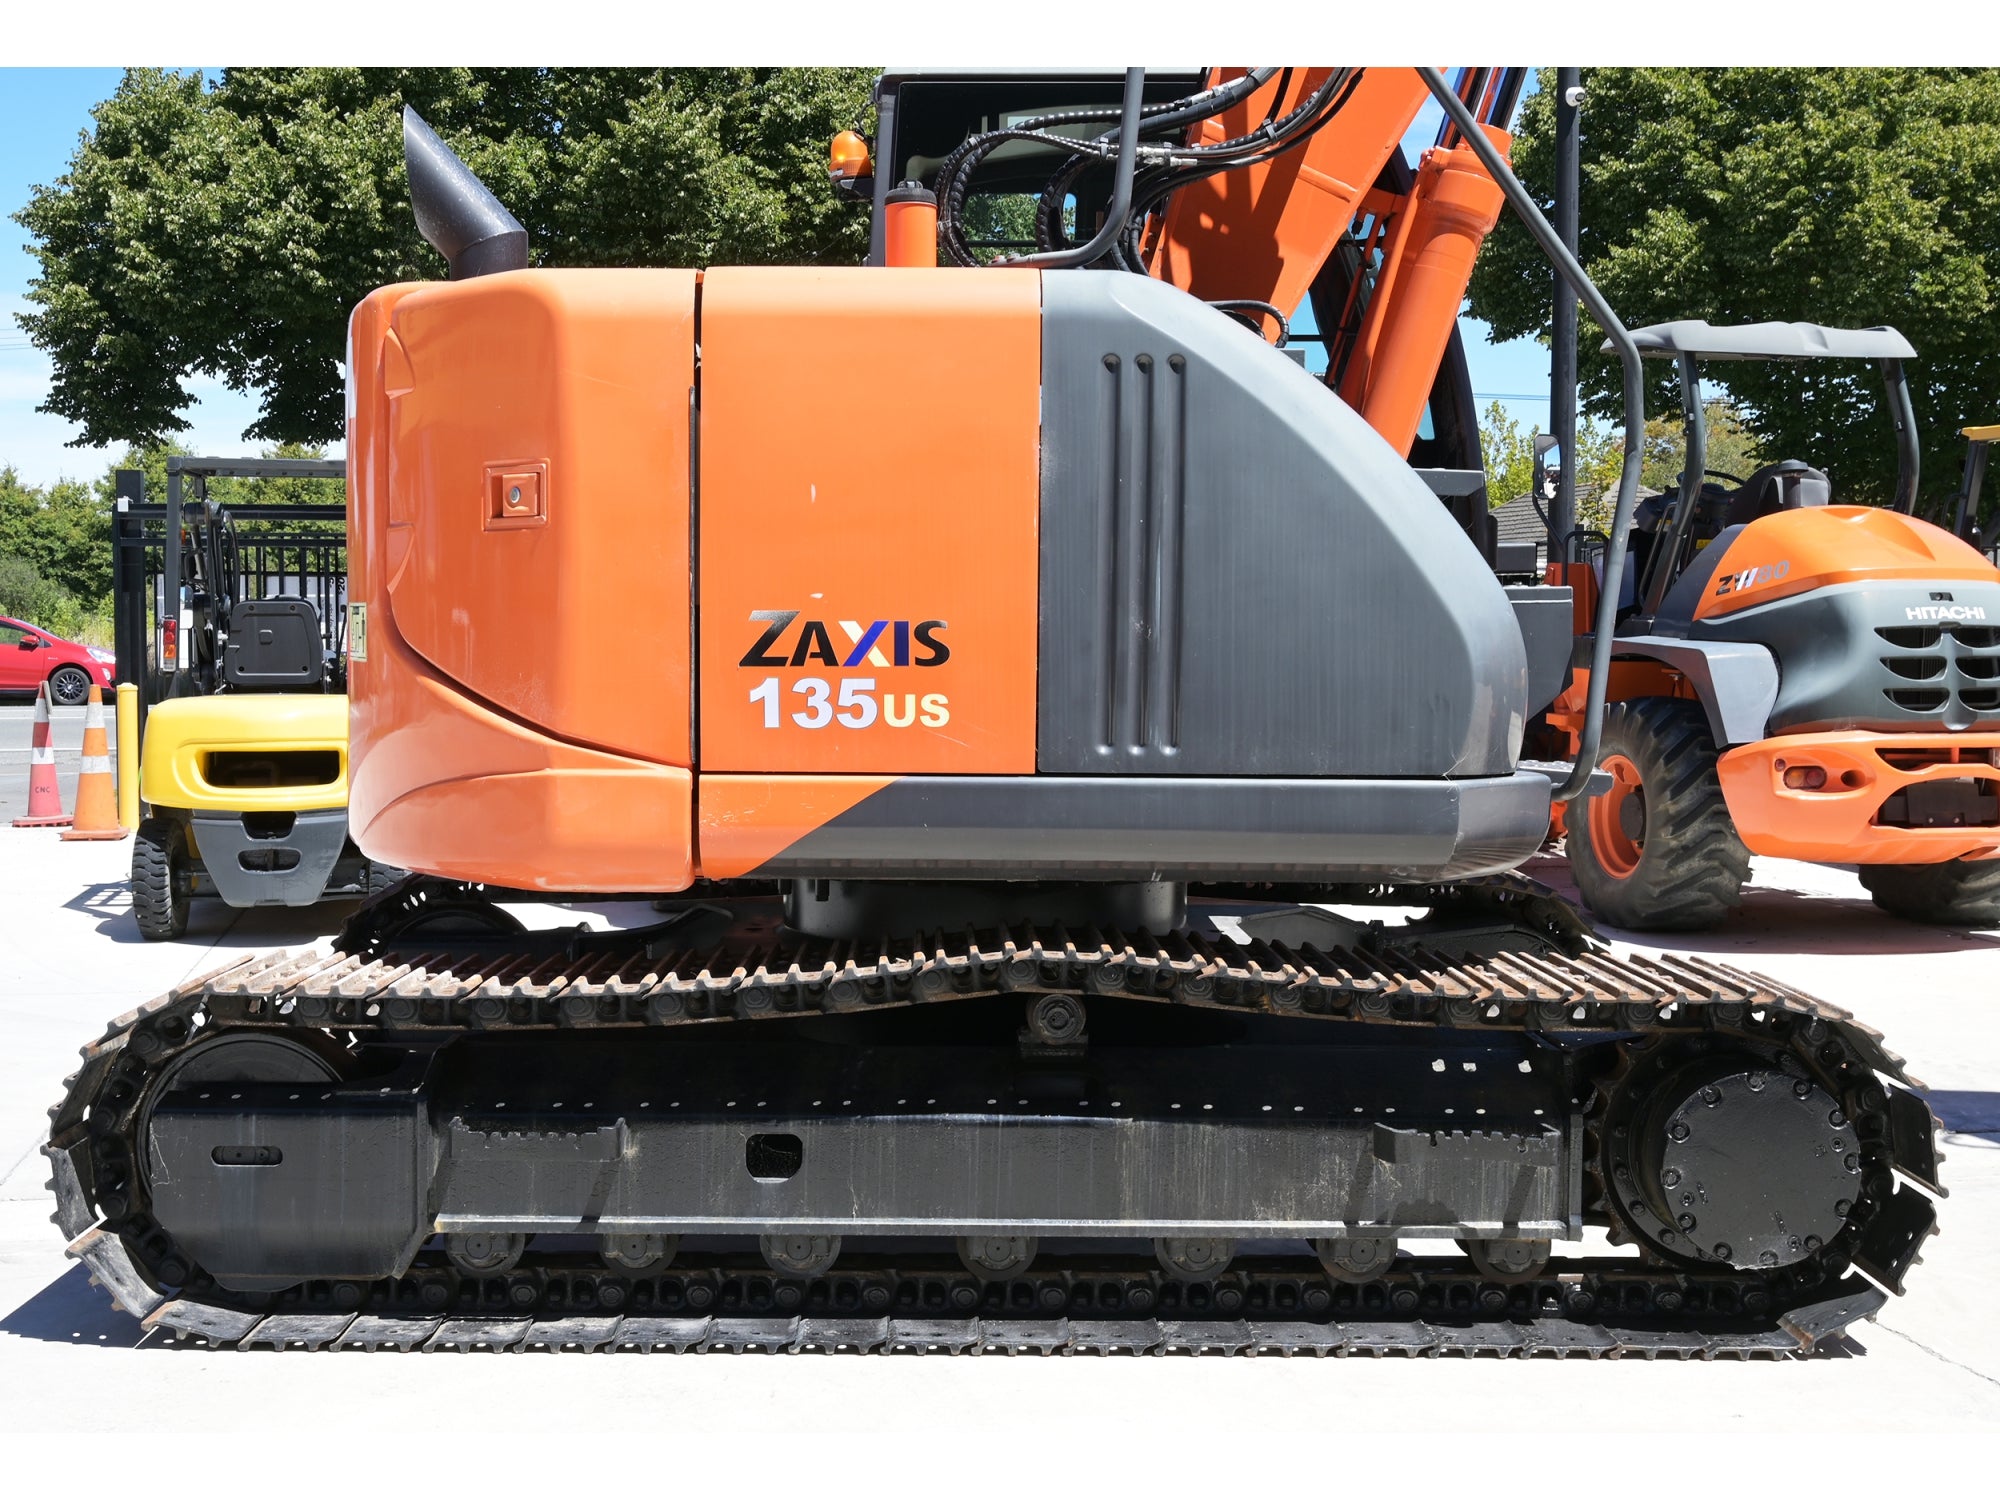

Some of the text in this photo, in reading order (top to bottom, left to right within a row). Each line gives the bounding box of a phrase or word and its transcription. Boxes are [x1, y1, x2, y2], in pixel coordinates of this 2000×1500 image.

[1715, 560, 1790, 597] ZW80
[1905, 606, 1986, 621] HITACHI
[738, 609, 951, 668] ZAXIS
[34, 786, 51, 794] CNC
